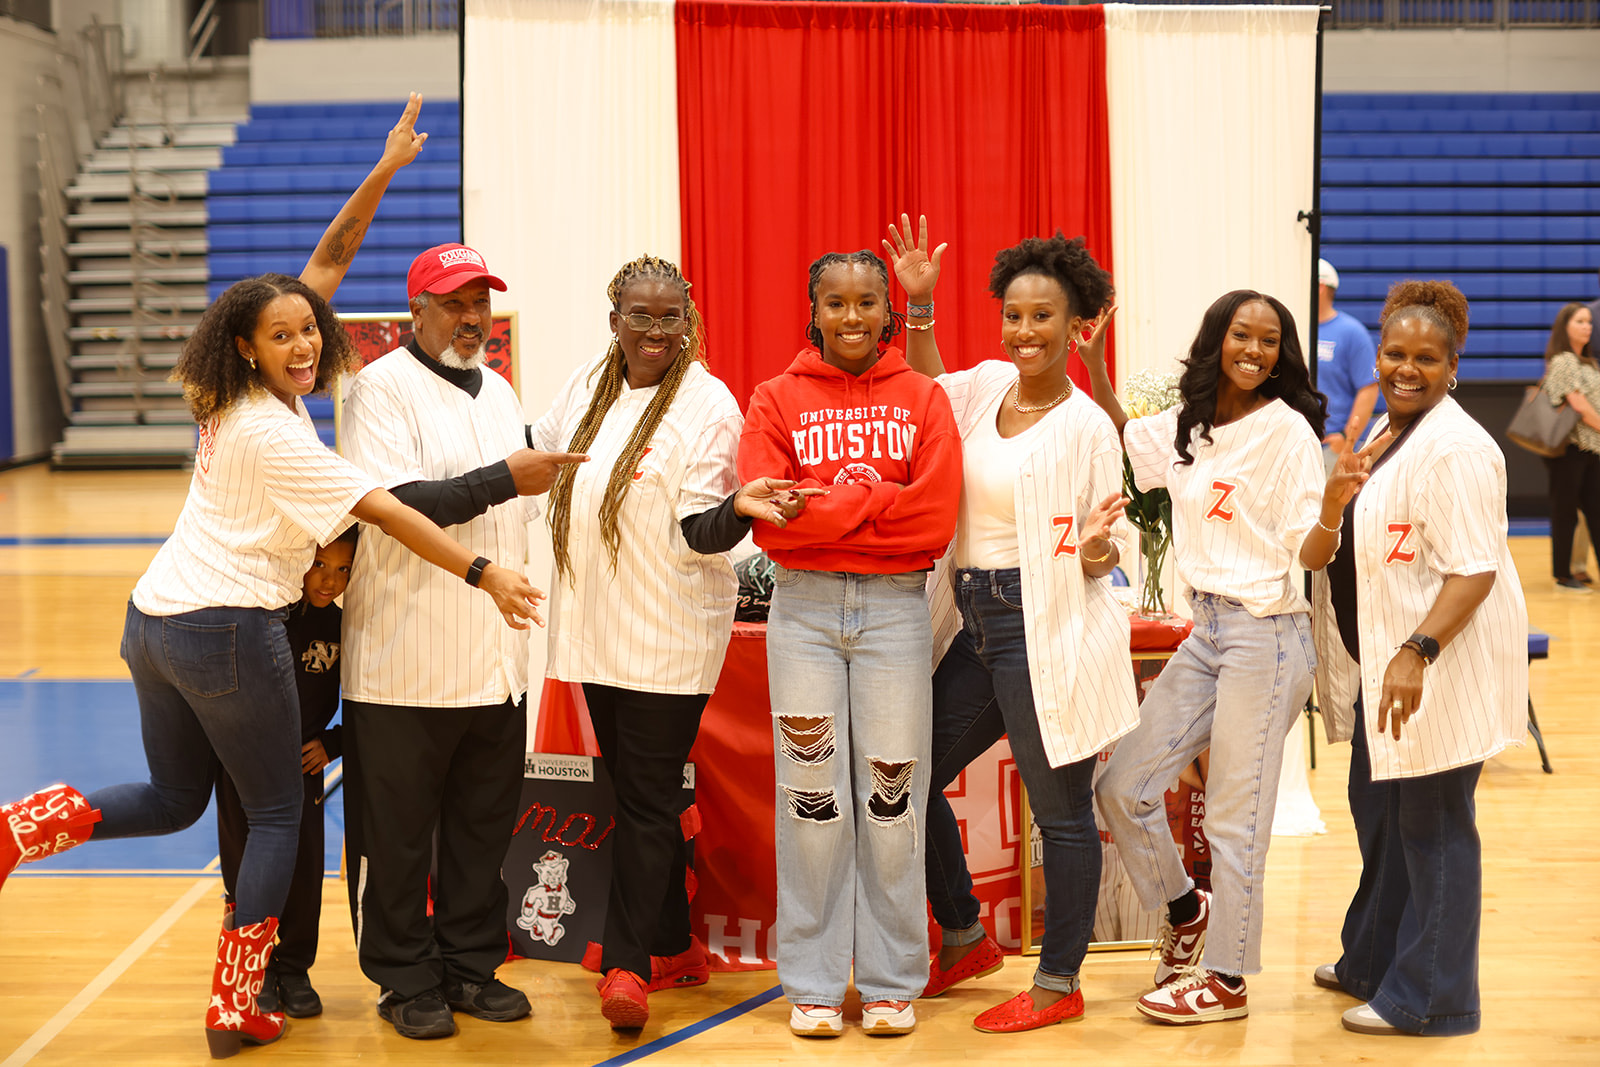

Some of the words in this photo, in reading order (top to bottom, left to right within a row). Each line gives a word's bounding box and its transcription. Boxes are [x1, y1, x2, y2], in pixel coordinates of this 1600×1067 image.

[800, 405, 888, 426] UNIVERSITY
[893, 406, 911, 422] OF
[792, 420, 917, 467] HOUSTON
[1205, 479, 1237, 523] Z
[1051, 514, 1078, 559] Z
[1386, 522, 1416, 564] Z
[538, 759, 578, 767] UNIVERSITY
[538, 766, 590, 778] HOUSTON
[548, 896, 562, 911] H
